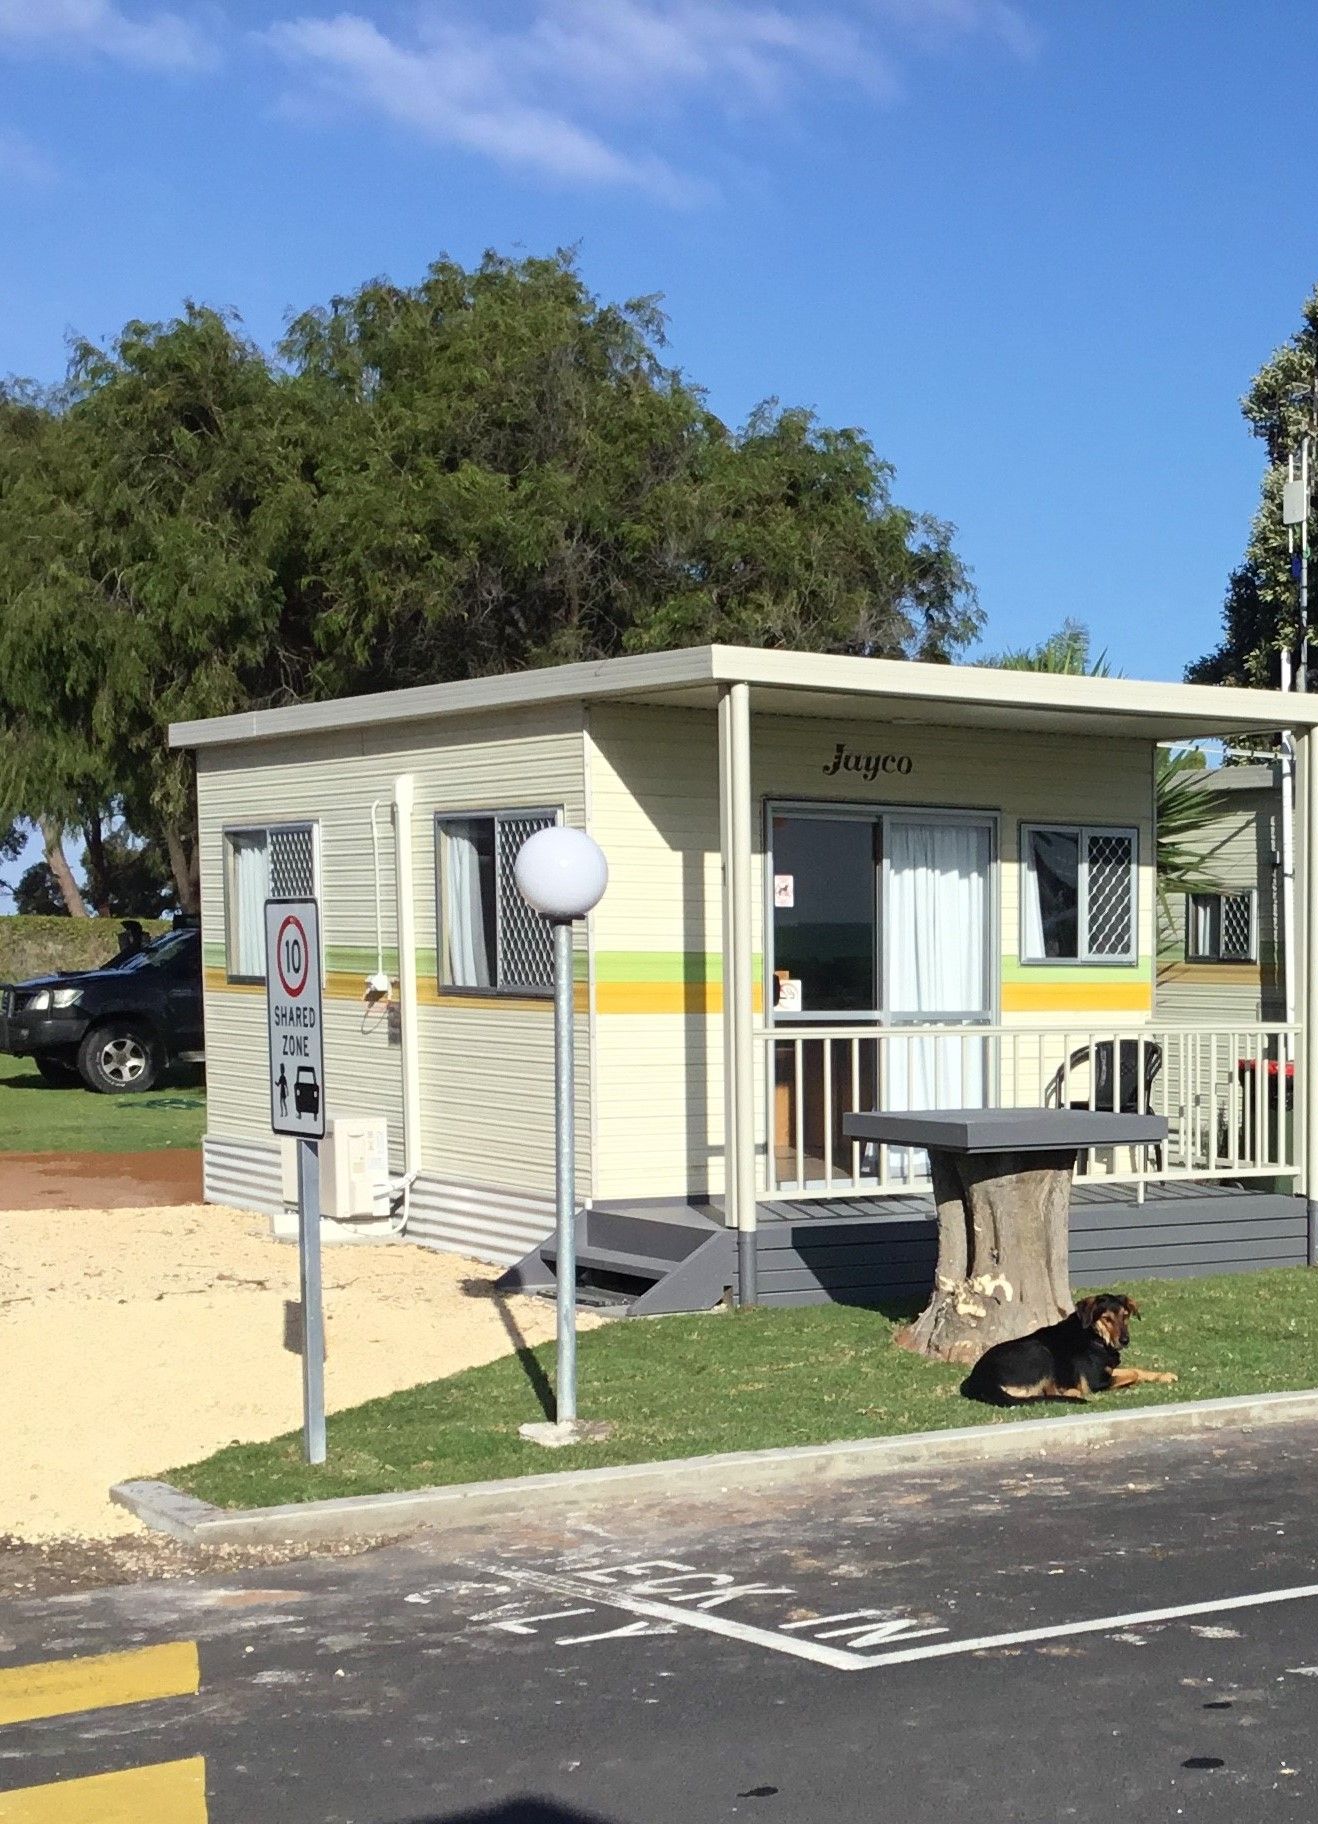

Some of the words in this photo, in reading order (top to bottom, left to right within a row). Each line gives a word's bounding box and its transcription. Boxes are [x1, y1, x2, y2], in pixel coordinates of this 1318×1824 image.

[822, 743, 913, 781] Jayco
[285, 939, 301, 974] 10
[274, 1005, 316, 1029] SHARED
[282, 1034, 309, 1057] ZONE
[778, 1609, 949, 1648] IN
